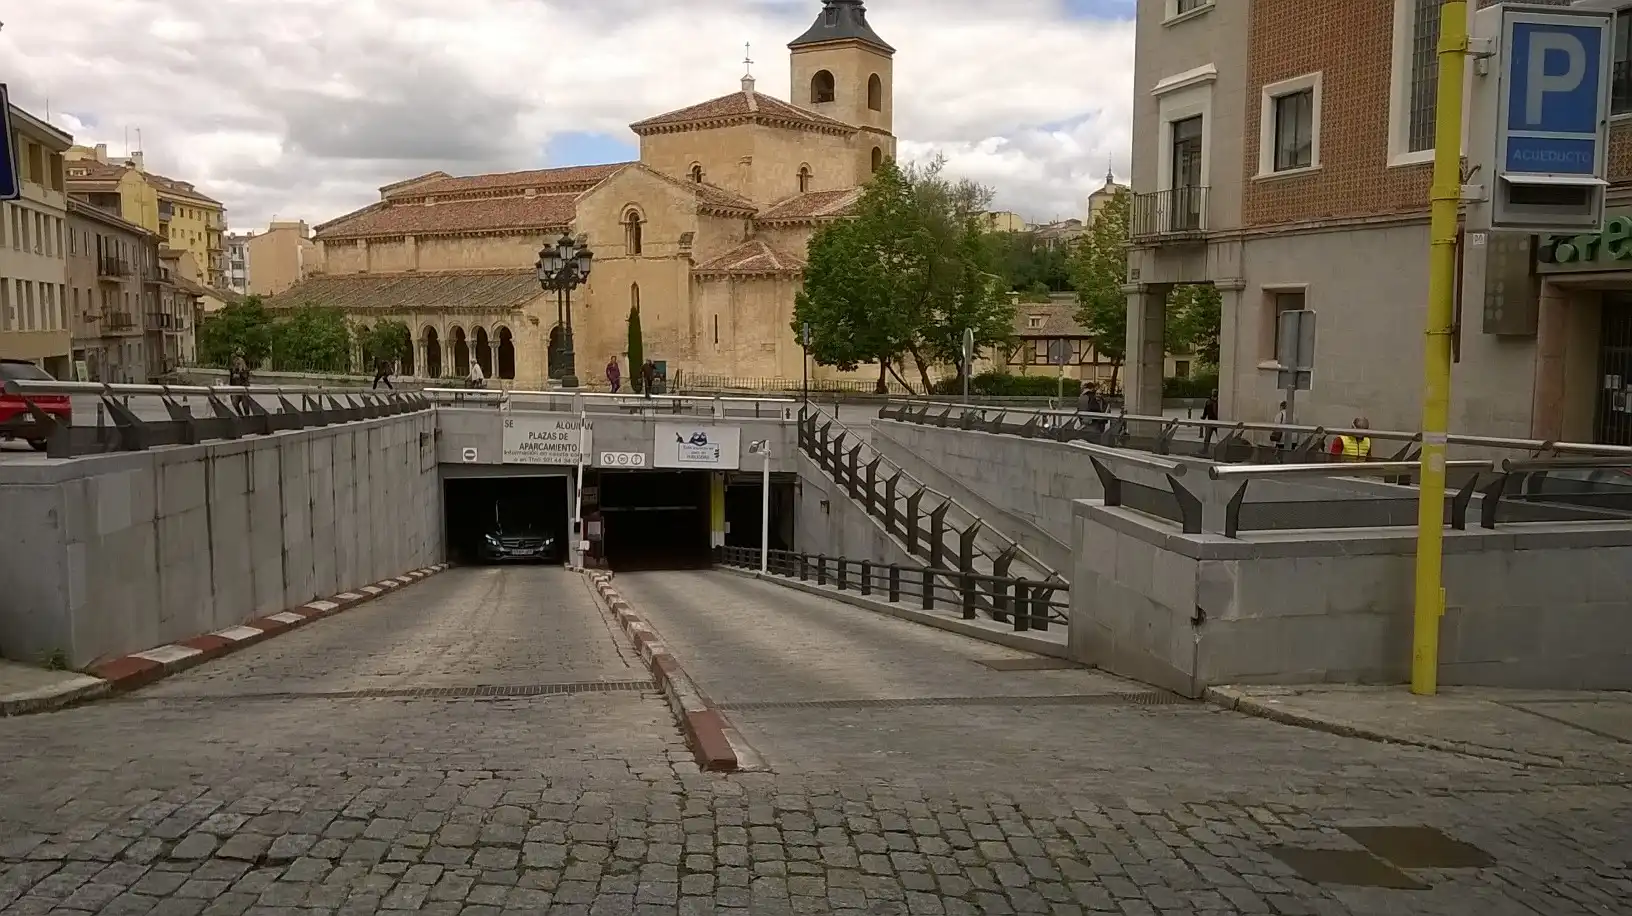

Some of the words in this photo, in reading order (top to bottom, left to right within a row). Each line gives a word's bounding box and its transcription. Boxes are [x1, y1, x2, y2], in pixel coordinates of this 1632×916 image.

[1526, 31, 1586, 125] P
[1513, 149, 1592, 165] ACUEDUCTO
[504, 420, 514, 428] SE
[529, 432, 557, 440] PLAZAS
[558, 433, 569, 441] DE
[519, 443, 578, 452] APARCAMIENTO
